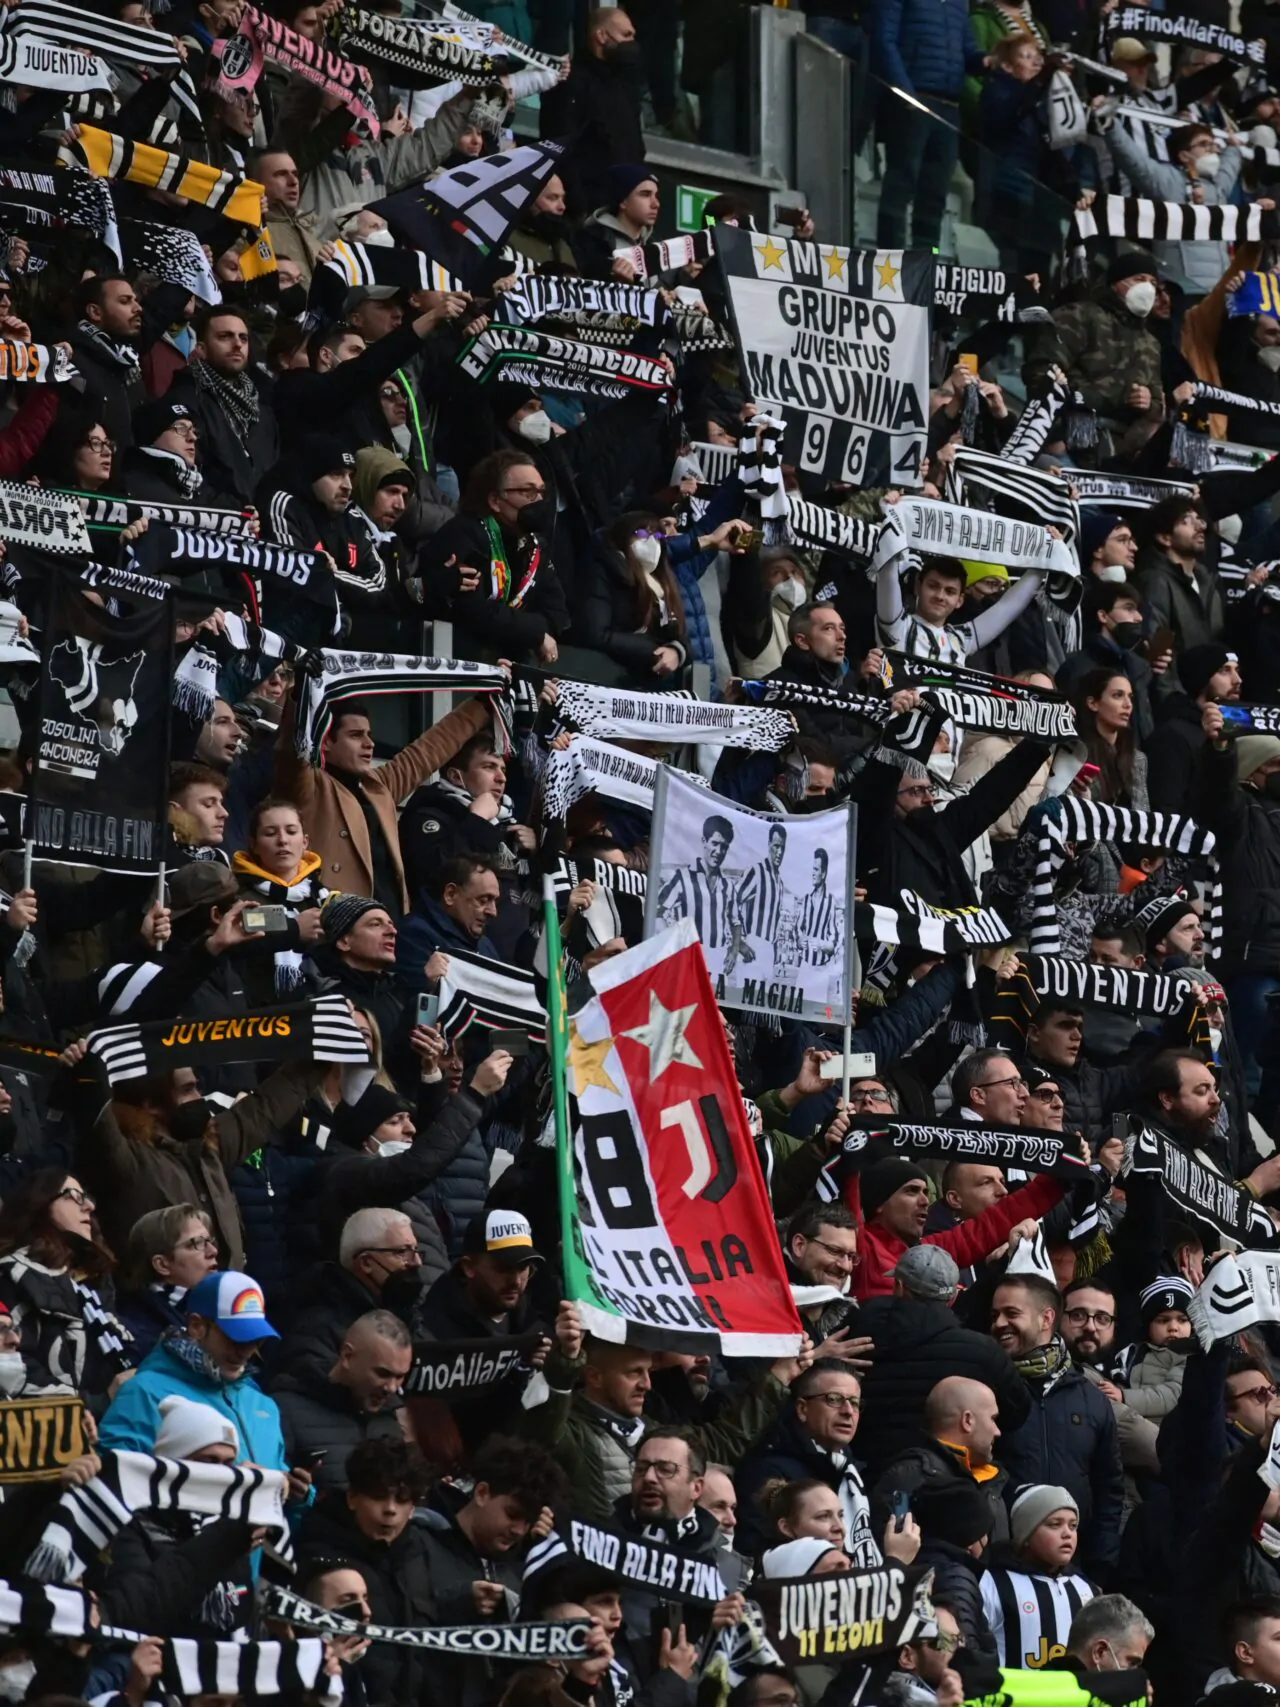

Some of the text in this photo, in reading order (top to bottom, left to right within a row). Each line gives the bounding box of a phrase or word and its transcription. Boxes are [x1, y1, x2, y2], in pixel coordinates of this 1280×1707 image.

[250, 6, 356, 87] VENTUS
[358, 9, 422, 50] FORZA
[438, 40, 484, 71] JUVE
[1122, 8, 1245, 54] #FinoAllaFine
[23, 45, 99, 77] JUVENTUS
[951, 265, 1007, 296] FIGLIO
[777, 285, 897, 344] GRUPPO
[546, 337, 674, 386] BIANCONE
[566, 361, 588, 373] 2010
[790, 330, 891, 374] JUVENTUS
[746, 349, 926, 431] MADUNINA
[170, 527, 316, 587] JUVENTUS
[612, 697, 735, 729] BORN TO SET NEW STANDARDS
[600, 752, 611, 774] TO
[69, 811, 117, 857] ALLA
[741, 976, 804, 1015] MAGLIA
[1036, 956, 1192, 1016] JUVENTUS
[162, 1015, 291, 1047] JUVENTUS
[889, 1123, 1064, 1167] JUVENTUS
[1163, 1139, 1241, 1228] FINO ALLA FINE
[491, 1223, 530, 1239] JUVENT
[588, 1272, 733, 1330] PADRONI
[570, 1520, 621, 1570] FINO
[621, 1541, 679, 1590] ALLA
[778, 1567, 905, 1640] JUVENTUS
[823, 1617, 883, 1653] LEONI
[1025, 1636, 1067, 1669] Je
